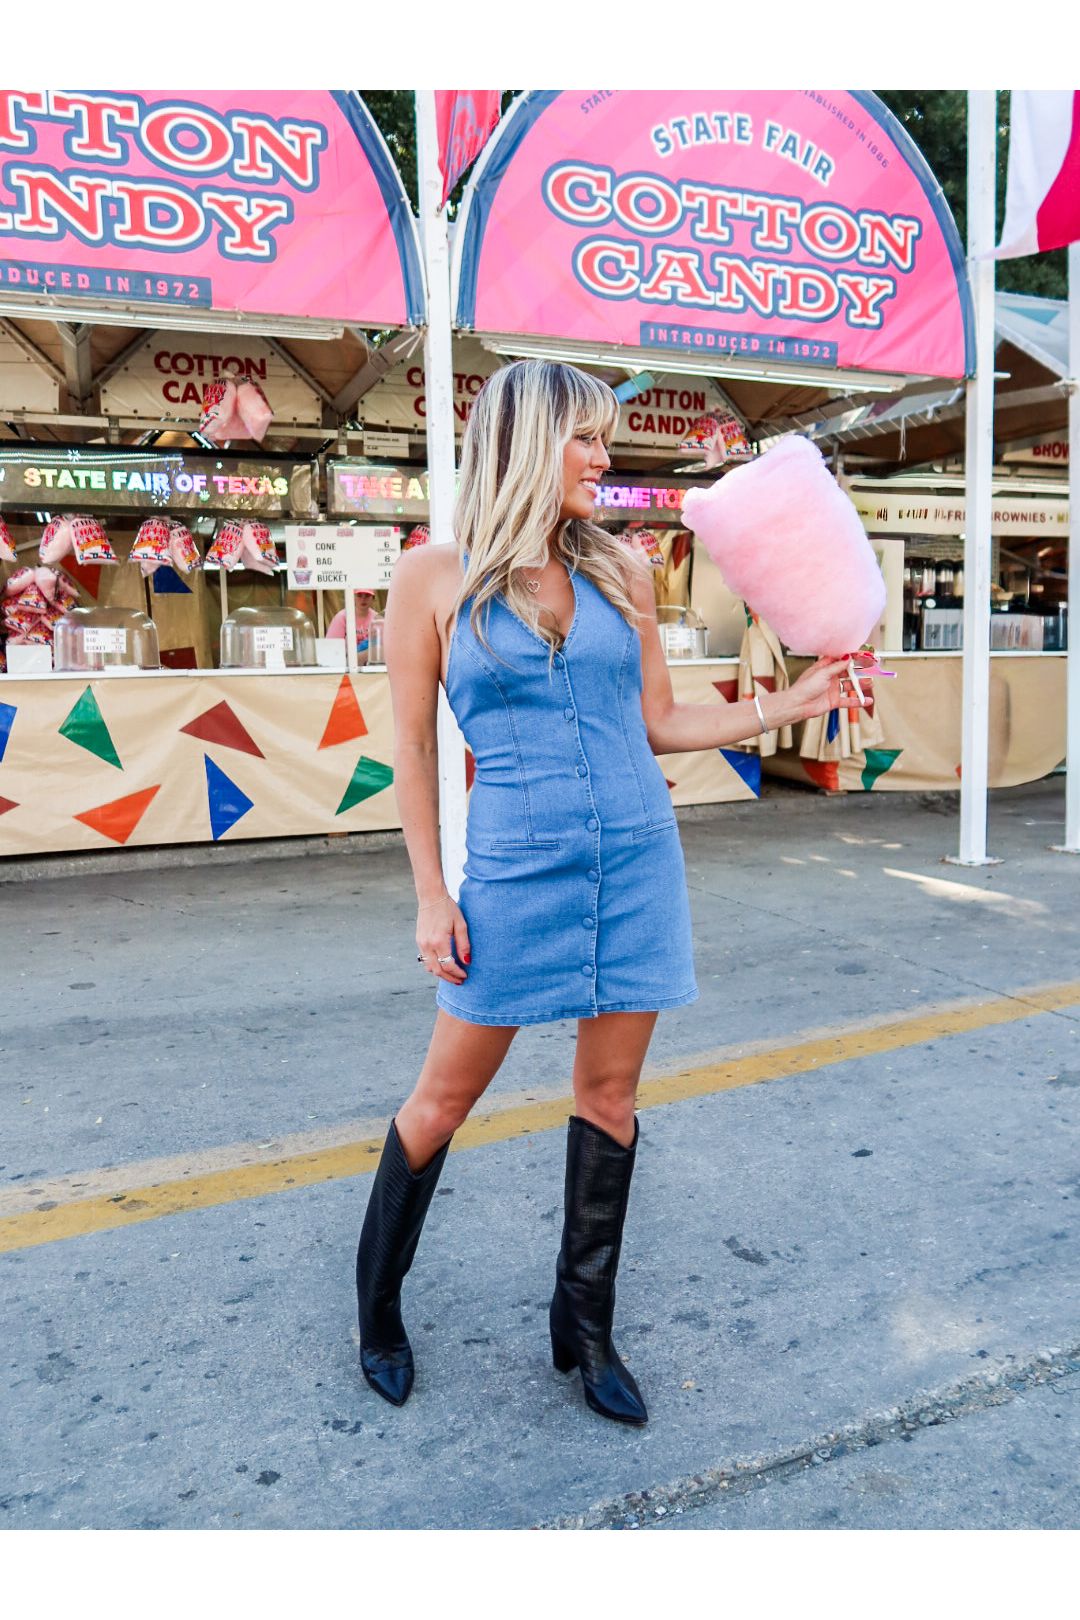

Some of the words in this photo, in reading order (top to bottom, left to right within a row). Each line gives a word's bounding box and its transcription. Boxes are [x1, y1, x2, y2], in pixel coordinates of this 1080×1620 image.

[653, 111, 752, 157] STATE
[763, 115, 834, 182] FAIR
[856, 129, 866, 142] IN
[0, 170, 287, 256] NDY
[546, 166, 920, 268] COTTON
[0, 267, 90, 290] DUCED
[105, 276, 129, 292] IN
[144, 279, 200, 299] 1972
[577, 240, 893, 326] CANDY
[650, 328, 760, 351] INTRODUCED
[769, 340, 785, 353] IN
[794, 344, 830, 359] 1972
[154, 350, 267, 380] COTTON
[24, 467, 106, 489] STATE
[112, 471, 172, 493] FAIR
[174, 474, 207, 494] OF
[213, 475, 289, 496] TEXAS
[339, 474, 402, 499] TAKE
[405, 477, 424, 500] A
[595, 485, 651, 509] HOME
[991, 511, 1046, 523] ROWNIES
[315, 542, 337, 551] CONE
[384, 541, 390, 549] 6
[316, 557, 332, 566] BAG
[384, 555, 391, 563] 8
[317, 574, 348, 583] BUCKET
